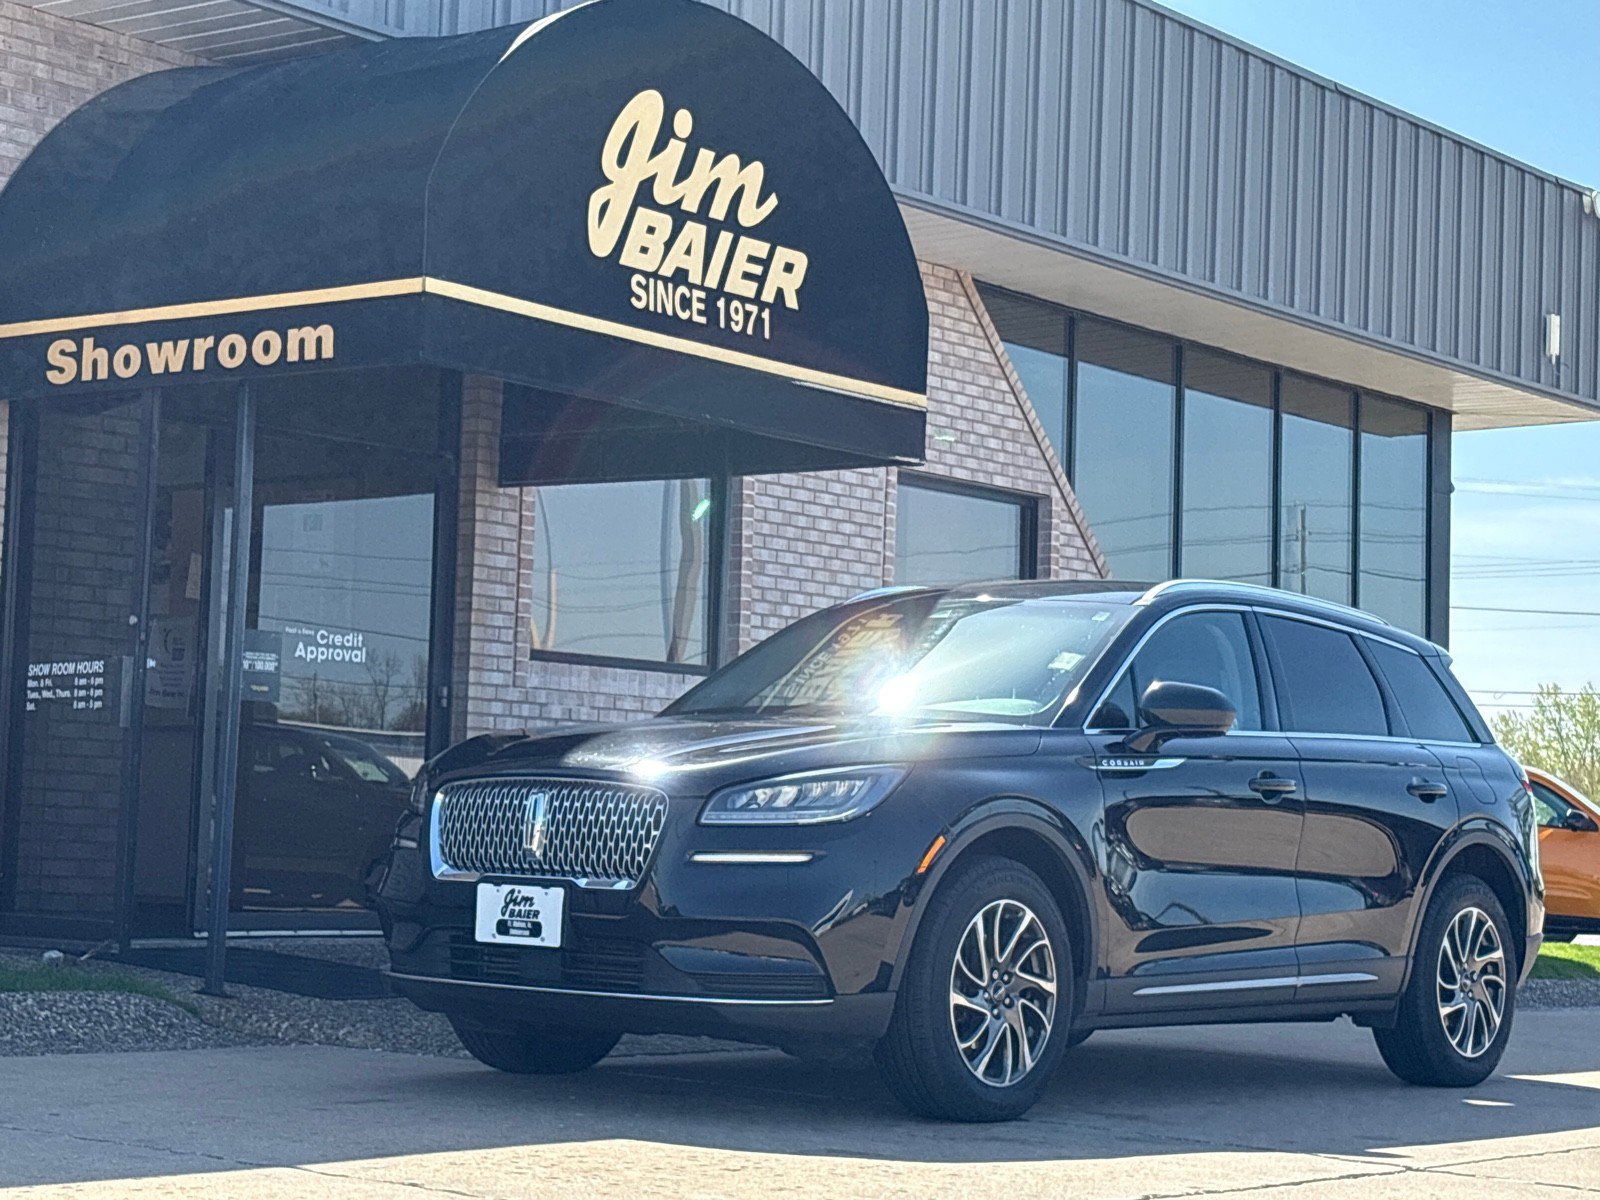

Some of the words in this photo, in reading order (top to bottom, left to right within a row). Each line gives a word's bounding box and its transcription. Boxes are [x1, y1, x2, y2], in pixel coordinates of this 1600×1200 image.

[587, 89, 778, 257] Jim
[619, 206, 809, 310] BAIER
[629, 274, 707, 324] SINCE
[716, 297, 771, 340] 1971
[45, 323, 335, 385] Showroom
[294, 641, 366, 663] Approval
[316, 629, 363, 647] Credit
[28, 664, 51, 676] SHOW
[51, 662, 75, 675] ROOM
[76, 660, 104, 673] HOURS
[501, 888, 535, 917] Jim
[508, 908, 540, 919] BAIER
